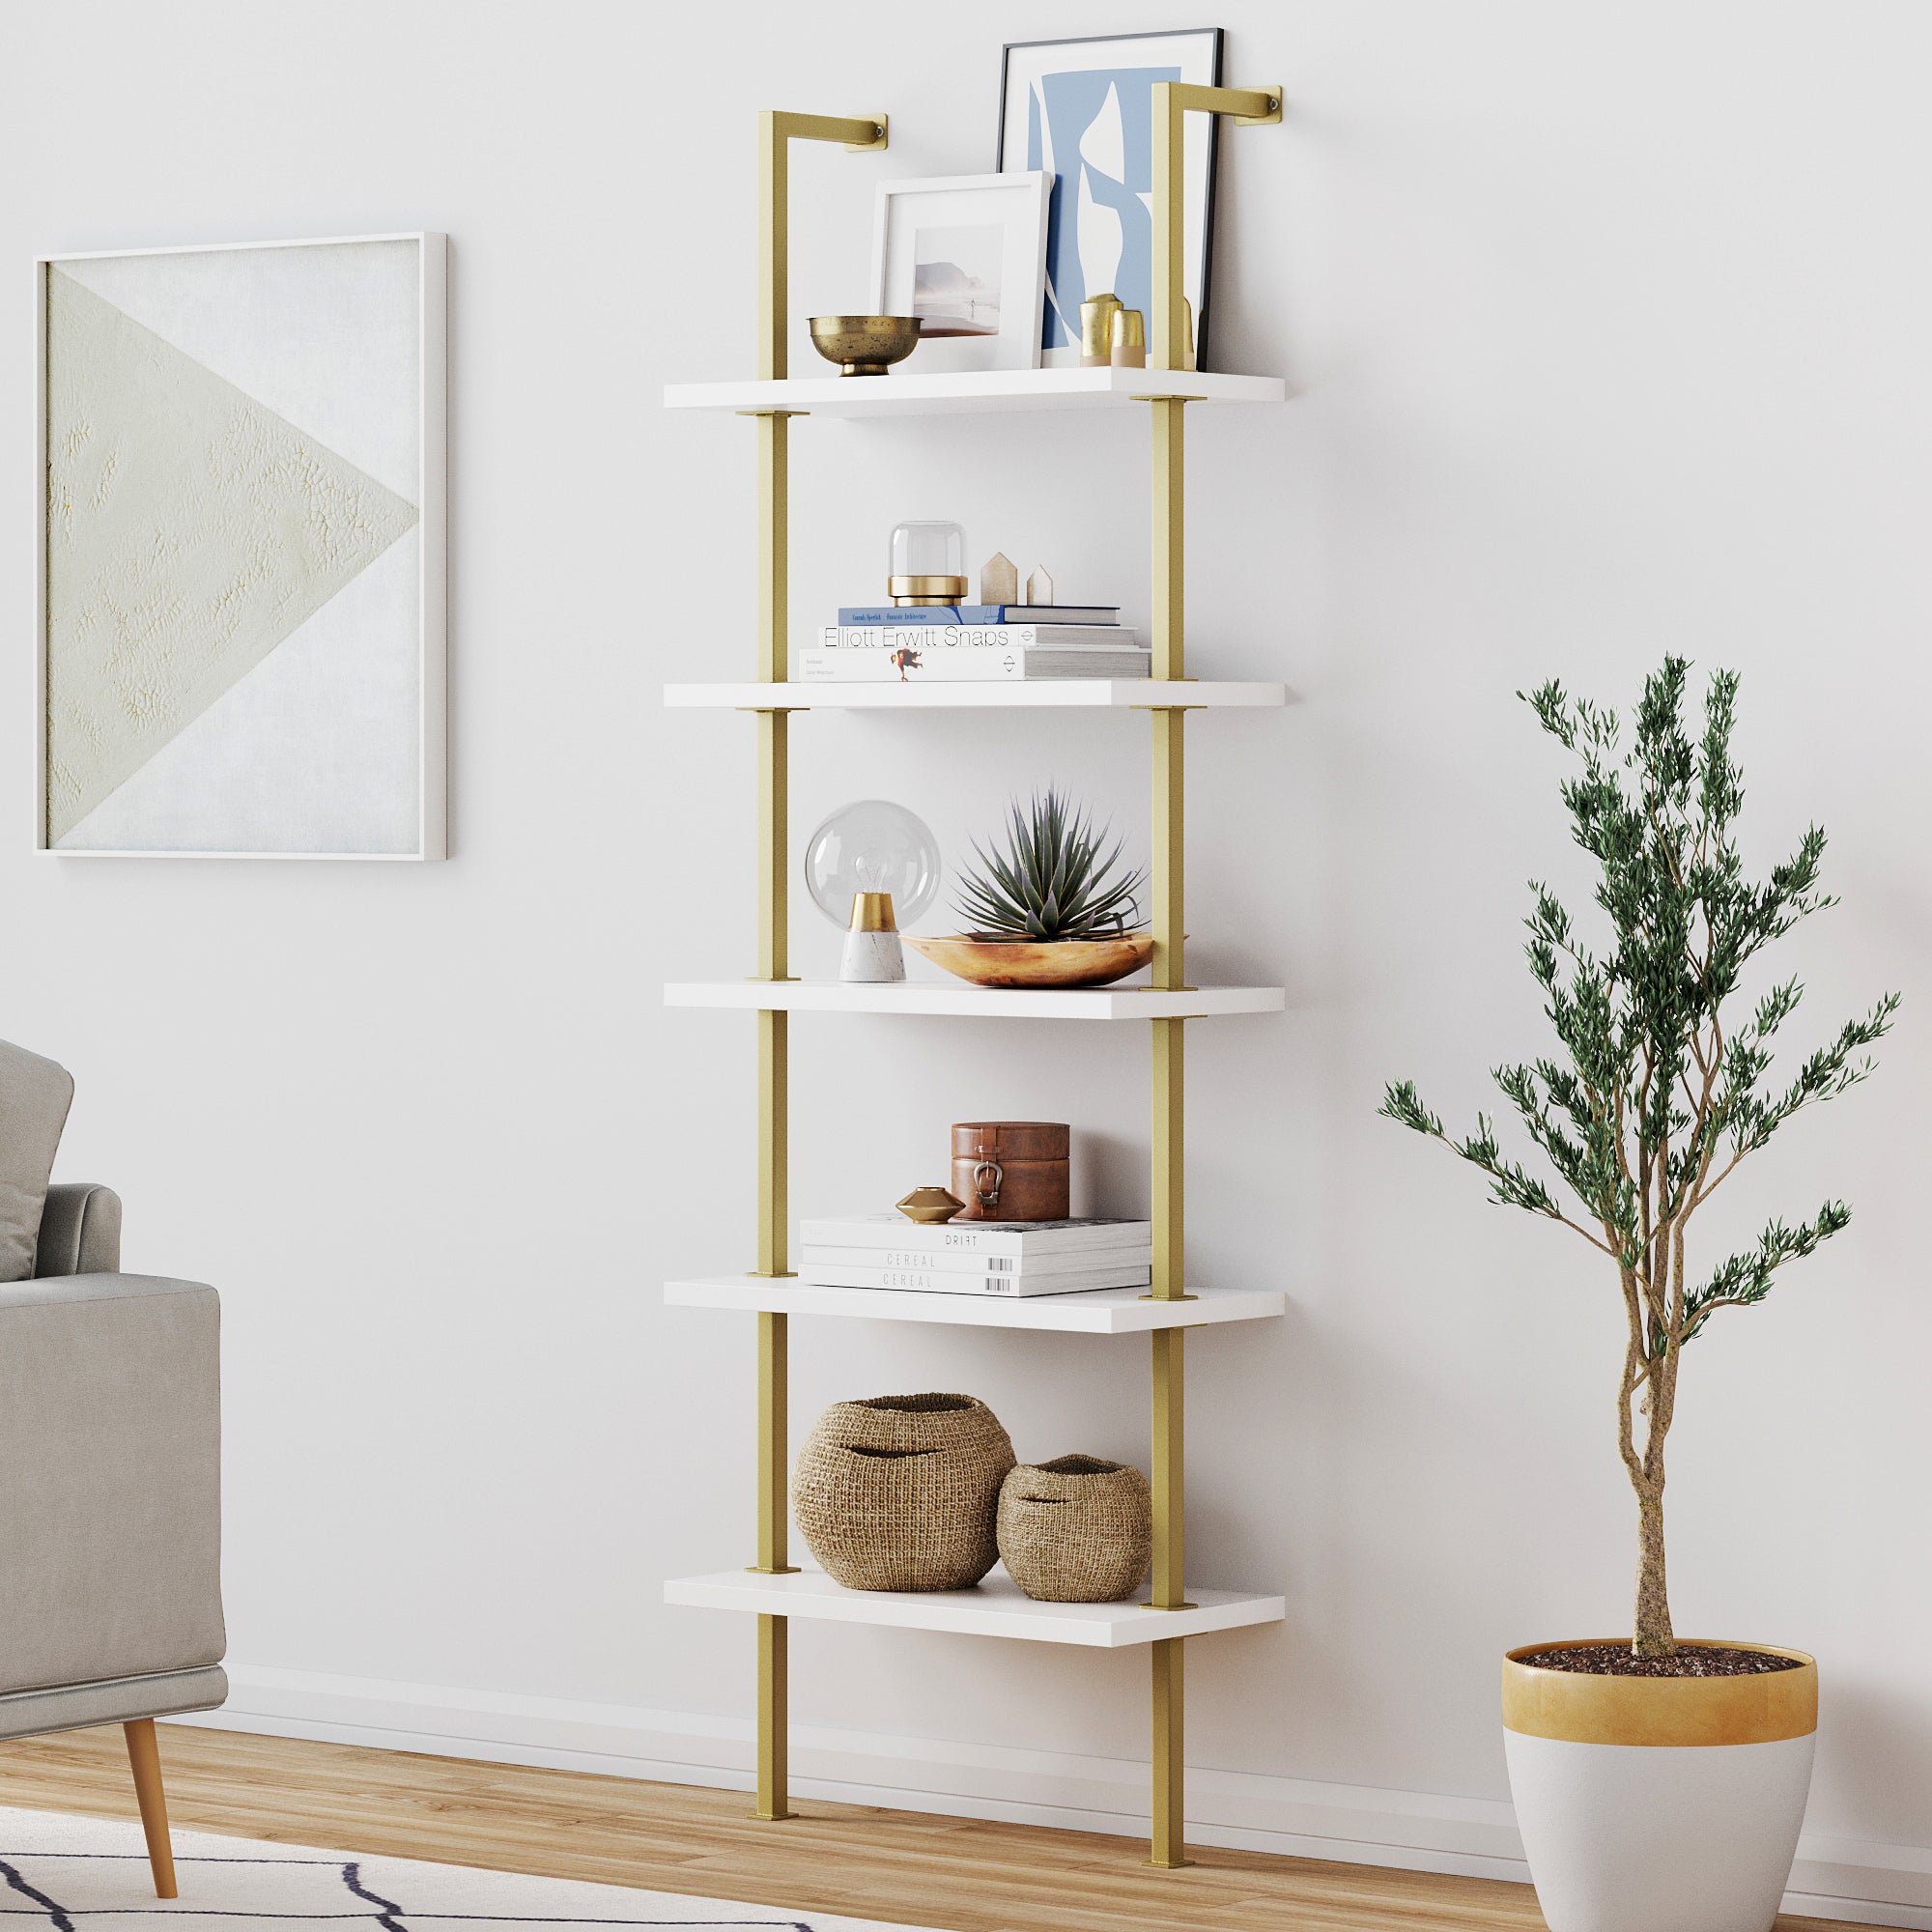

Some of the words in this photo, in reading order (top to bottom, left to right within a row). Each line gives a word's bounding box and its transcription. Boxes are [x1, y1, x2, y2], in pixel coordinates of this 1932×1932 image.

[825, 627, 875, 647] Elliott
[883, 627, 937, 647] Erwitt
[944, 625, 1009, 647] Snaps
[887, 1253, 935, 1267] CEREAL
[883, 1273, 932, 1288] CEREAL
